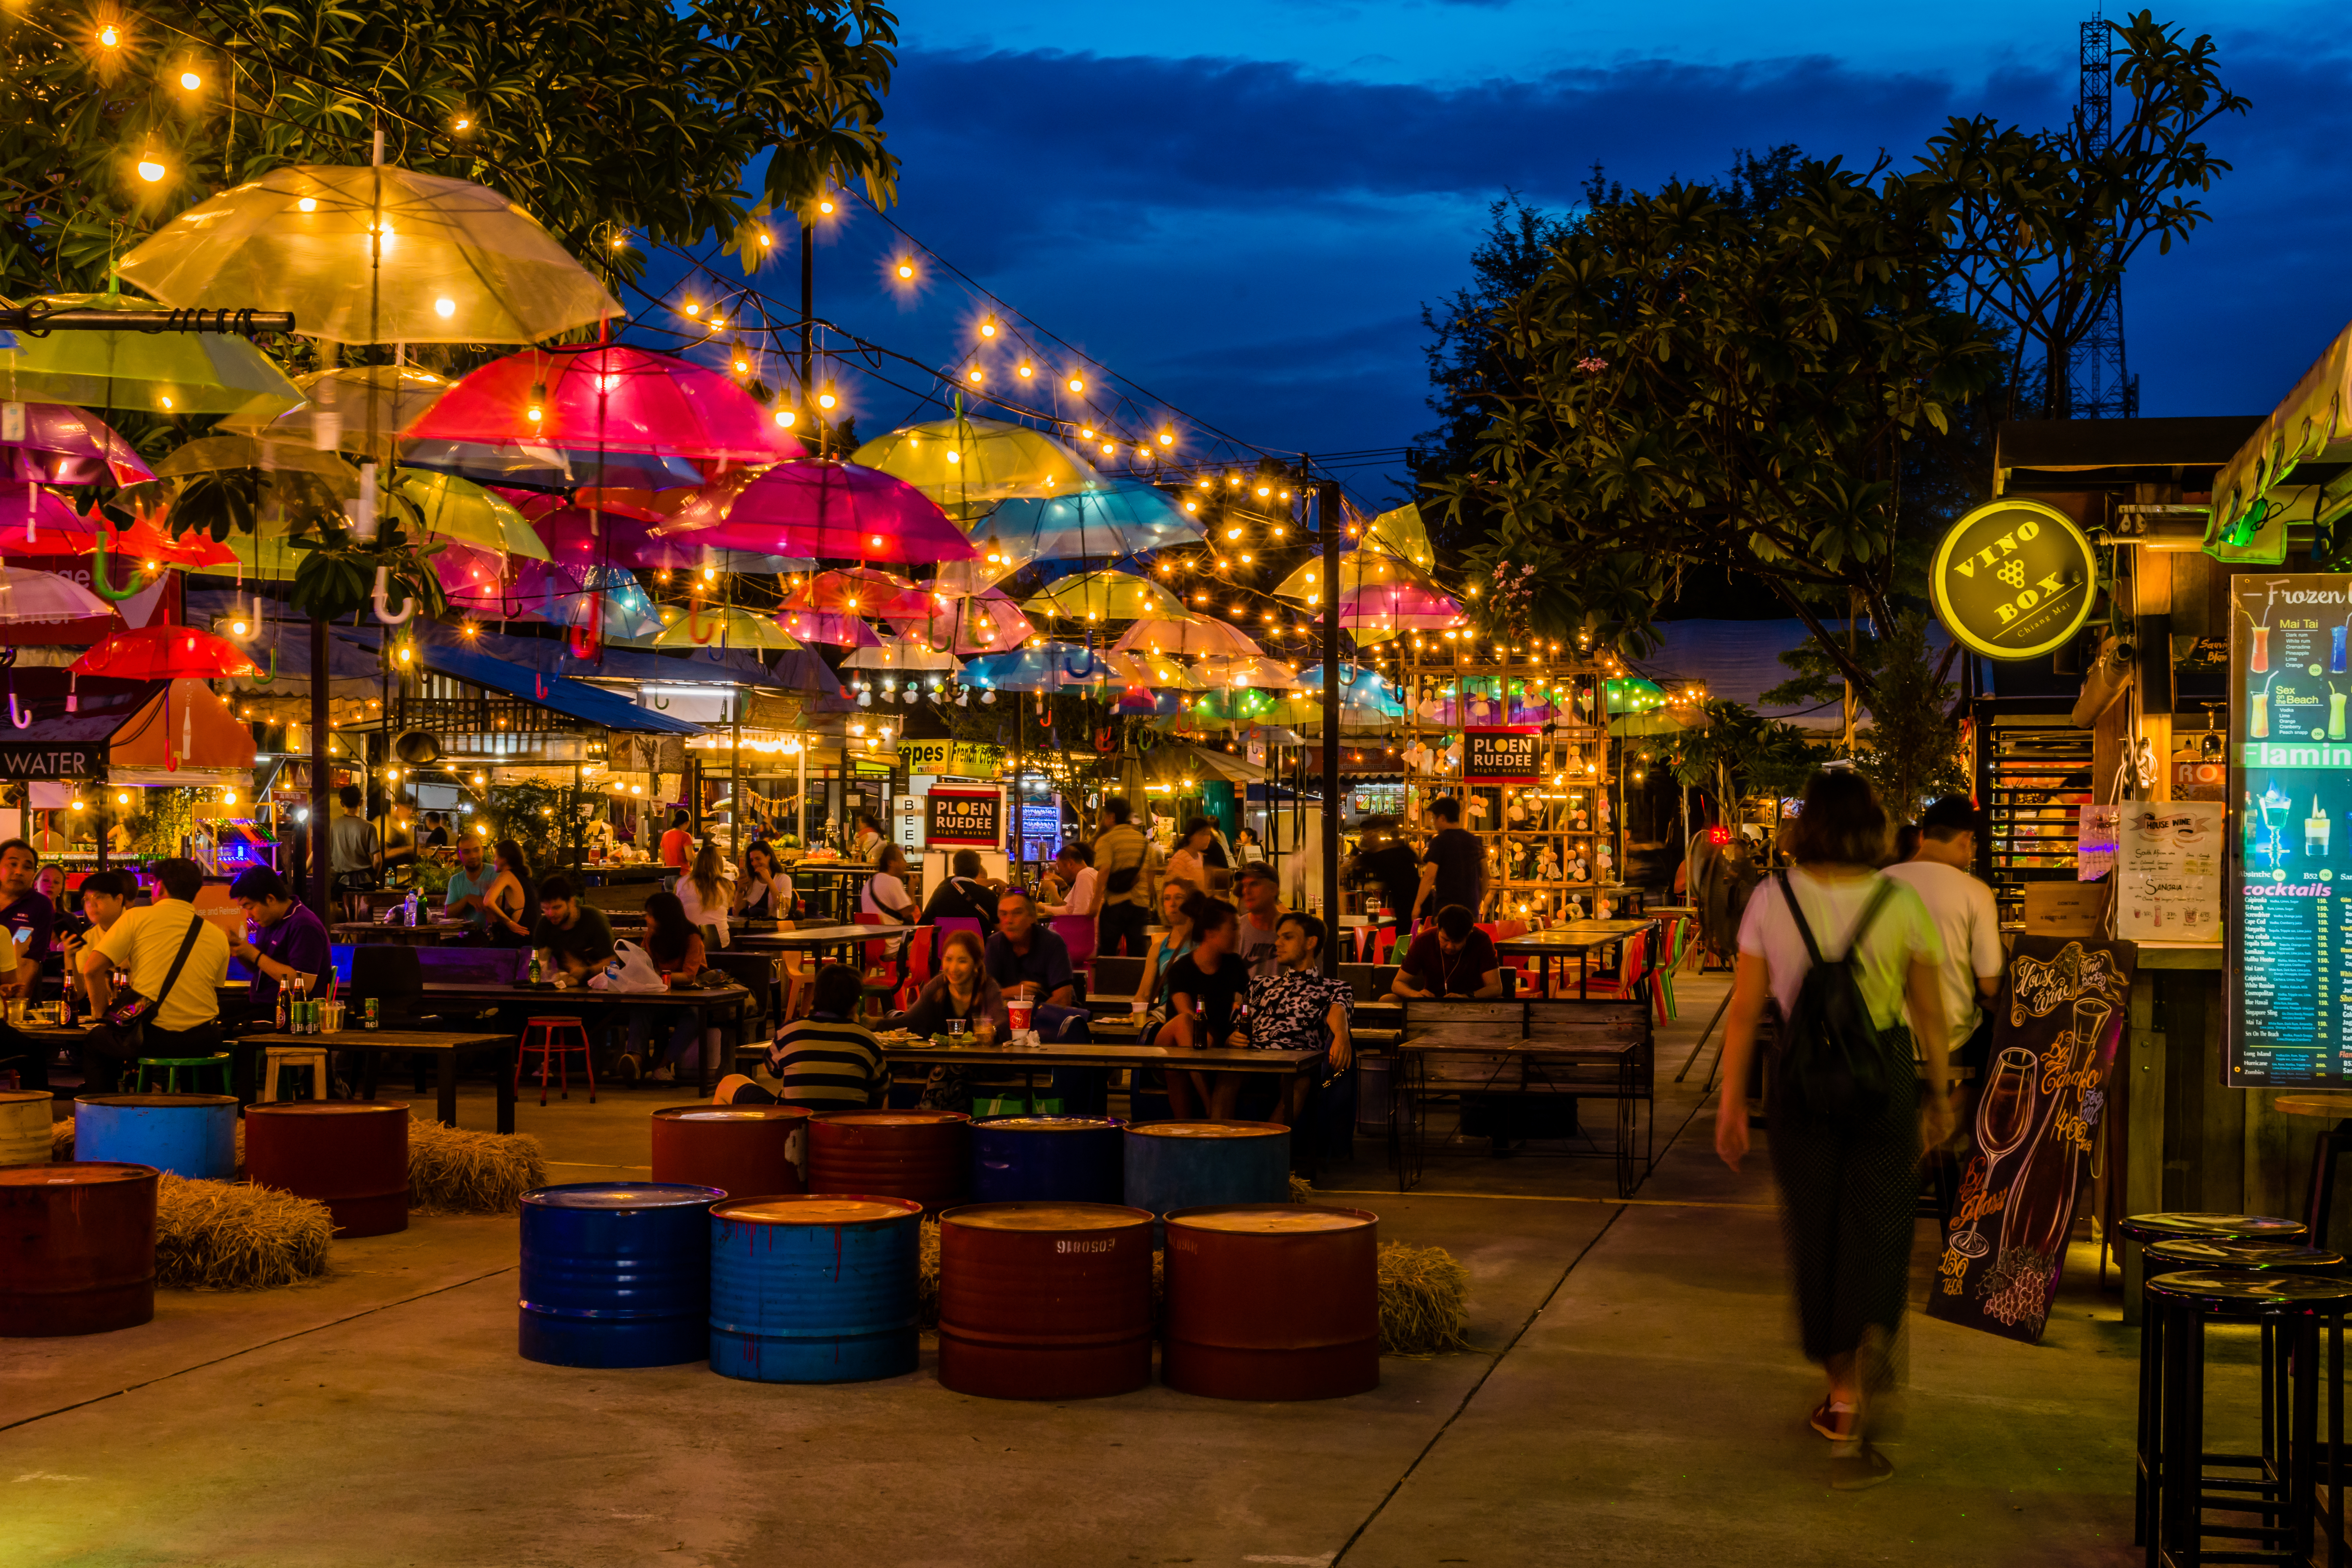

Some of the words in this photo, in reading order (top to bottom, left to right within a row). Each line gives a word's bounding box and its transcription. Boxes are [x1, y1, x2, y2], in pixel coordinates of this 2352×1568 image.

[1954, 521, 2039, 578] VINO
[1994, 572, 2065, 624] BOX
[2265, 579, 2345, 605] Frozen
[2017, 615, 2050, 637] Chiang
[2052, 601, 2070, 615] Mai
[2280, 619, 2300, 629] Mai
[2303, 619, 2318, 629] Tai
[2276, 686, 2295, 694] Sex
[2287, 695, 2319, 704] Beach
[951, 742, 977, 763] French
[1474, 739, 1532, 753] PLOEN
[2240, 742, 2352, 765] Flamin
[4, 753, 84, 774] WATER
[1474, 754, 1531, 766] RUEDEE
[2178, 764, 2226, 782] RO
[937, 801, 992, 816] PLOEN
[904, 800, 915, 855] BEER
[936, 816, 991, 829] RUEDEE
[2147, 821, 2169, 829] HOUSE
[2172, 818, 2191, 826] WINE
[2145, 879, 2182, 895] SANGRIA
[2242, 882, 2332, 896] cocktails
[2080, 956, 2104, 975] Vino
[2016, 962, 2055, 996] House
[2033, 977, 2071, 1012] Wine
[1938, 1247, 1968, 1278] 150
